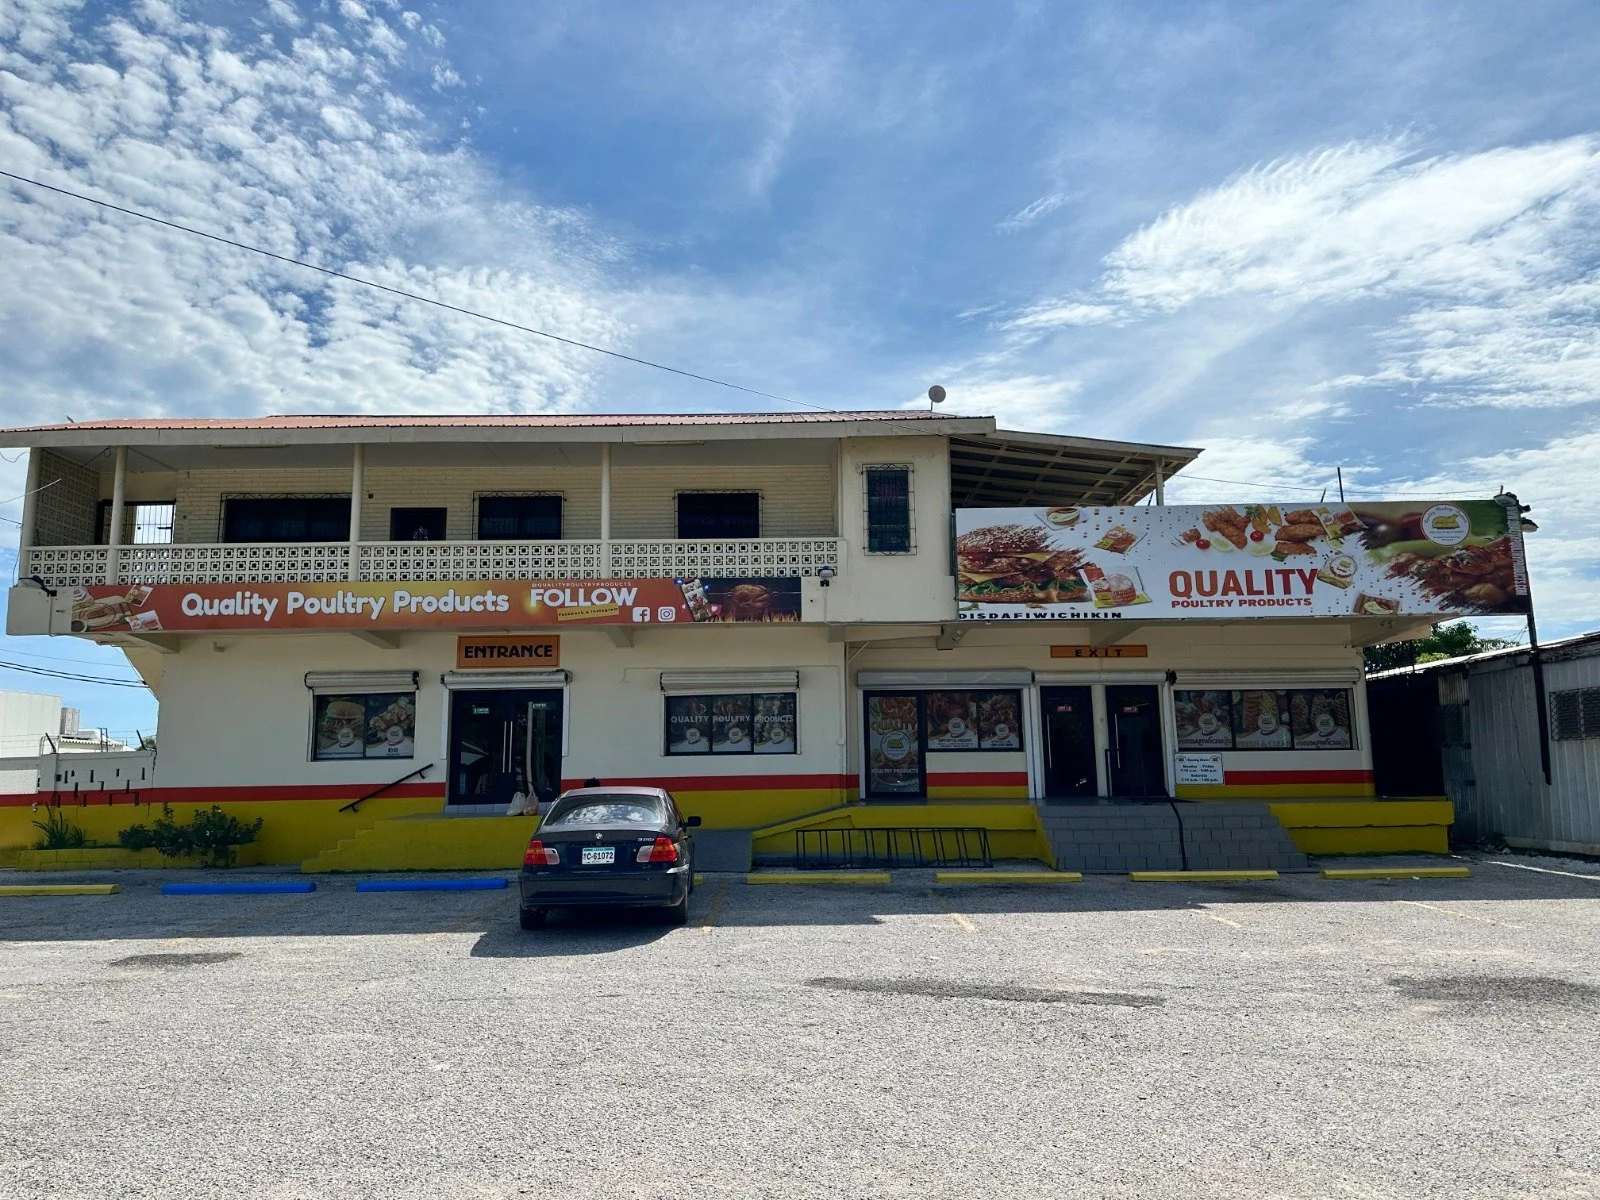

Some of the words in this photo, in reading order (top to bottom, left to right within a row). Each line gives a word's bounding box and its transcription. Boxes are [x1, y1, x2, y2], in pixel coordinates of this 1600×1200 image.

[1169, 569, 1318, 599] QUALITY
[530, 588, 638, 608] FOLLOW
[1171, 600, 1234, 608] POULTRY
[1239, 598, 1312, 607] PRODUCTS
[181, 591, 278, 621] Quality
[287, 590, 386, 620] Poultry
[393, 589, 510, 614] Products
[958, 612, 1122, 620] DISDAFIWICHIKIN
[464, 645, 553, 658] ENTRANCE
[1075, 649, 1123, 657] EXIT
[671, 715, 709, 723] QUALITY
[754, 714, 794, 722] PRODUCTS
